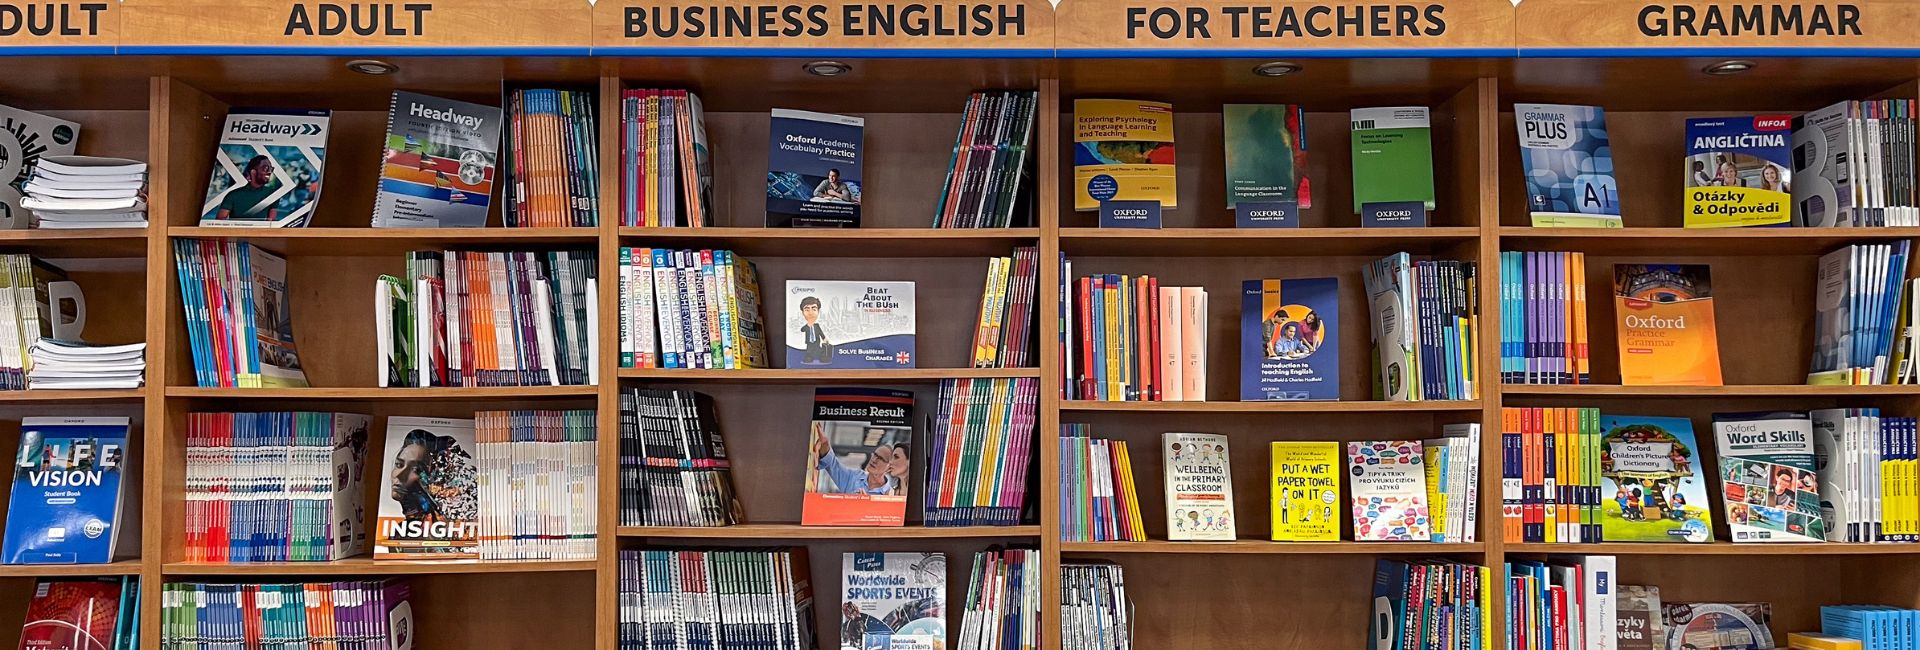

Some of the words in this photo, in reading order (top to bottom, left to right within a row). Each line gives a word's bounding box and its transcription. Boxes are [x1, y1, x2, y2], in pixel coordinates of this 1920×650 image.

[284, 4, 432, 37] ADULT
[624, 5, 829, 38] BUSINESS
[843, 4, 1025, 37] ENGLISH
[1126, 7, 1211, 39] FOR
[1222, 5, 1446, 38] TEACHERS
[1637, 4, 1863, 36] GRAMMAR
[410, 103, 483, 130] Headway
[1115, 116, 1157, 124] Psychology
[1524, 112, 1565, 122] GRAMMAR
[230, 121, 300, 138] Headway
[1525, 121, 1567, 140] PLUS
[786, 134, 817, 145] Oxford
[818, 138, 856, 150] Academic
[1694, 133, 1785, 149] ANGLIČTINA
[780, 142, 824, 155] Vocabulary
[825, 147, 856, 158] Practice
[1584, 182, 1610, 208] A1
[1693, 191, 1745, 203] Otázky
[1693, 205, 1703, 214] &
[1707, 202, 1779, 216] Odpovědi
[677, 270, 689, 306] ENGLISH
[694, 271, 706, 307] ENGLISH
[1626, 315, 1686, 329] Oxford
[681, 310, 694, 350] EVERYONE
[1626, 329, 1665, 337] Practice
[1627, 338, 1675, 347] Grammar
[819, 405, 868, 416] Business
[869, 406, 905, 417] Result
[1726, 424, 1756, 433] Oxford
[1727, 432, 1767, 444] Word
[1770, 431, 1805, 442] Skills
[1176, 465, 1222, 474] WELLBEING
[1282, 464, 1300, 474] PUT
[1302, 465, 1308, 473] A
[1310, 464, 1330, 474] WET
[29, 470, 103, 487] VISION
[1278, 477, 1305, 487] PAPER
[1308, 477, 1335, 487] TOWEL
[44, 490, 66, 498] Student
[1176, 484, 1222, 492] CLASSROOM
[1292, 490, 1304, 499] ON
[1309, 489, 1320, 500] IT
[382, 520, 478, 539] INSIGHT
[848, 575, 906, 586] Worldwide
[847, 587, 892, 599] SPORTS
[896, 587, 937, 599] EVENTS
